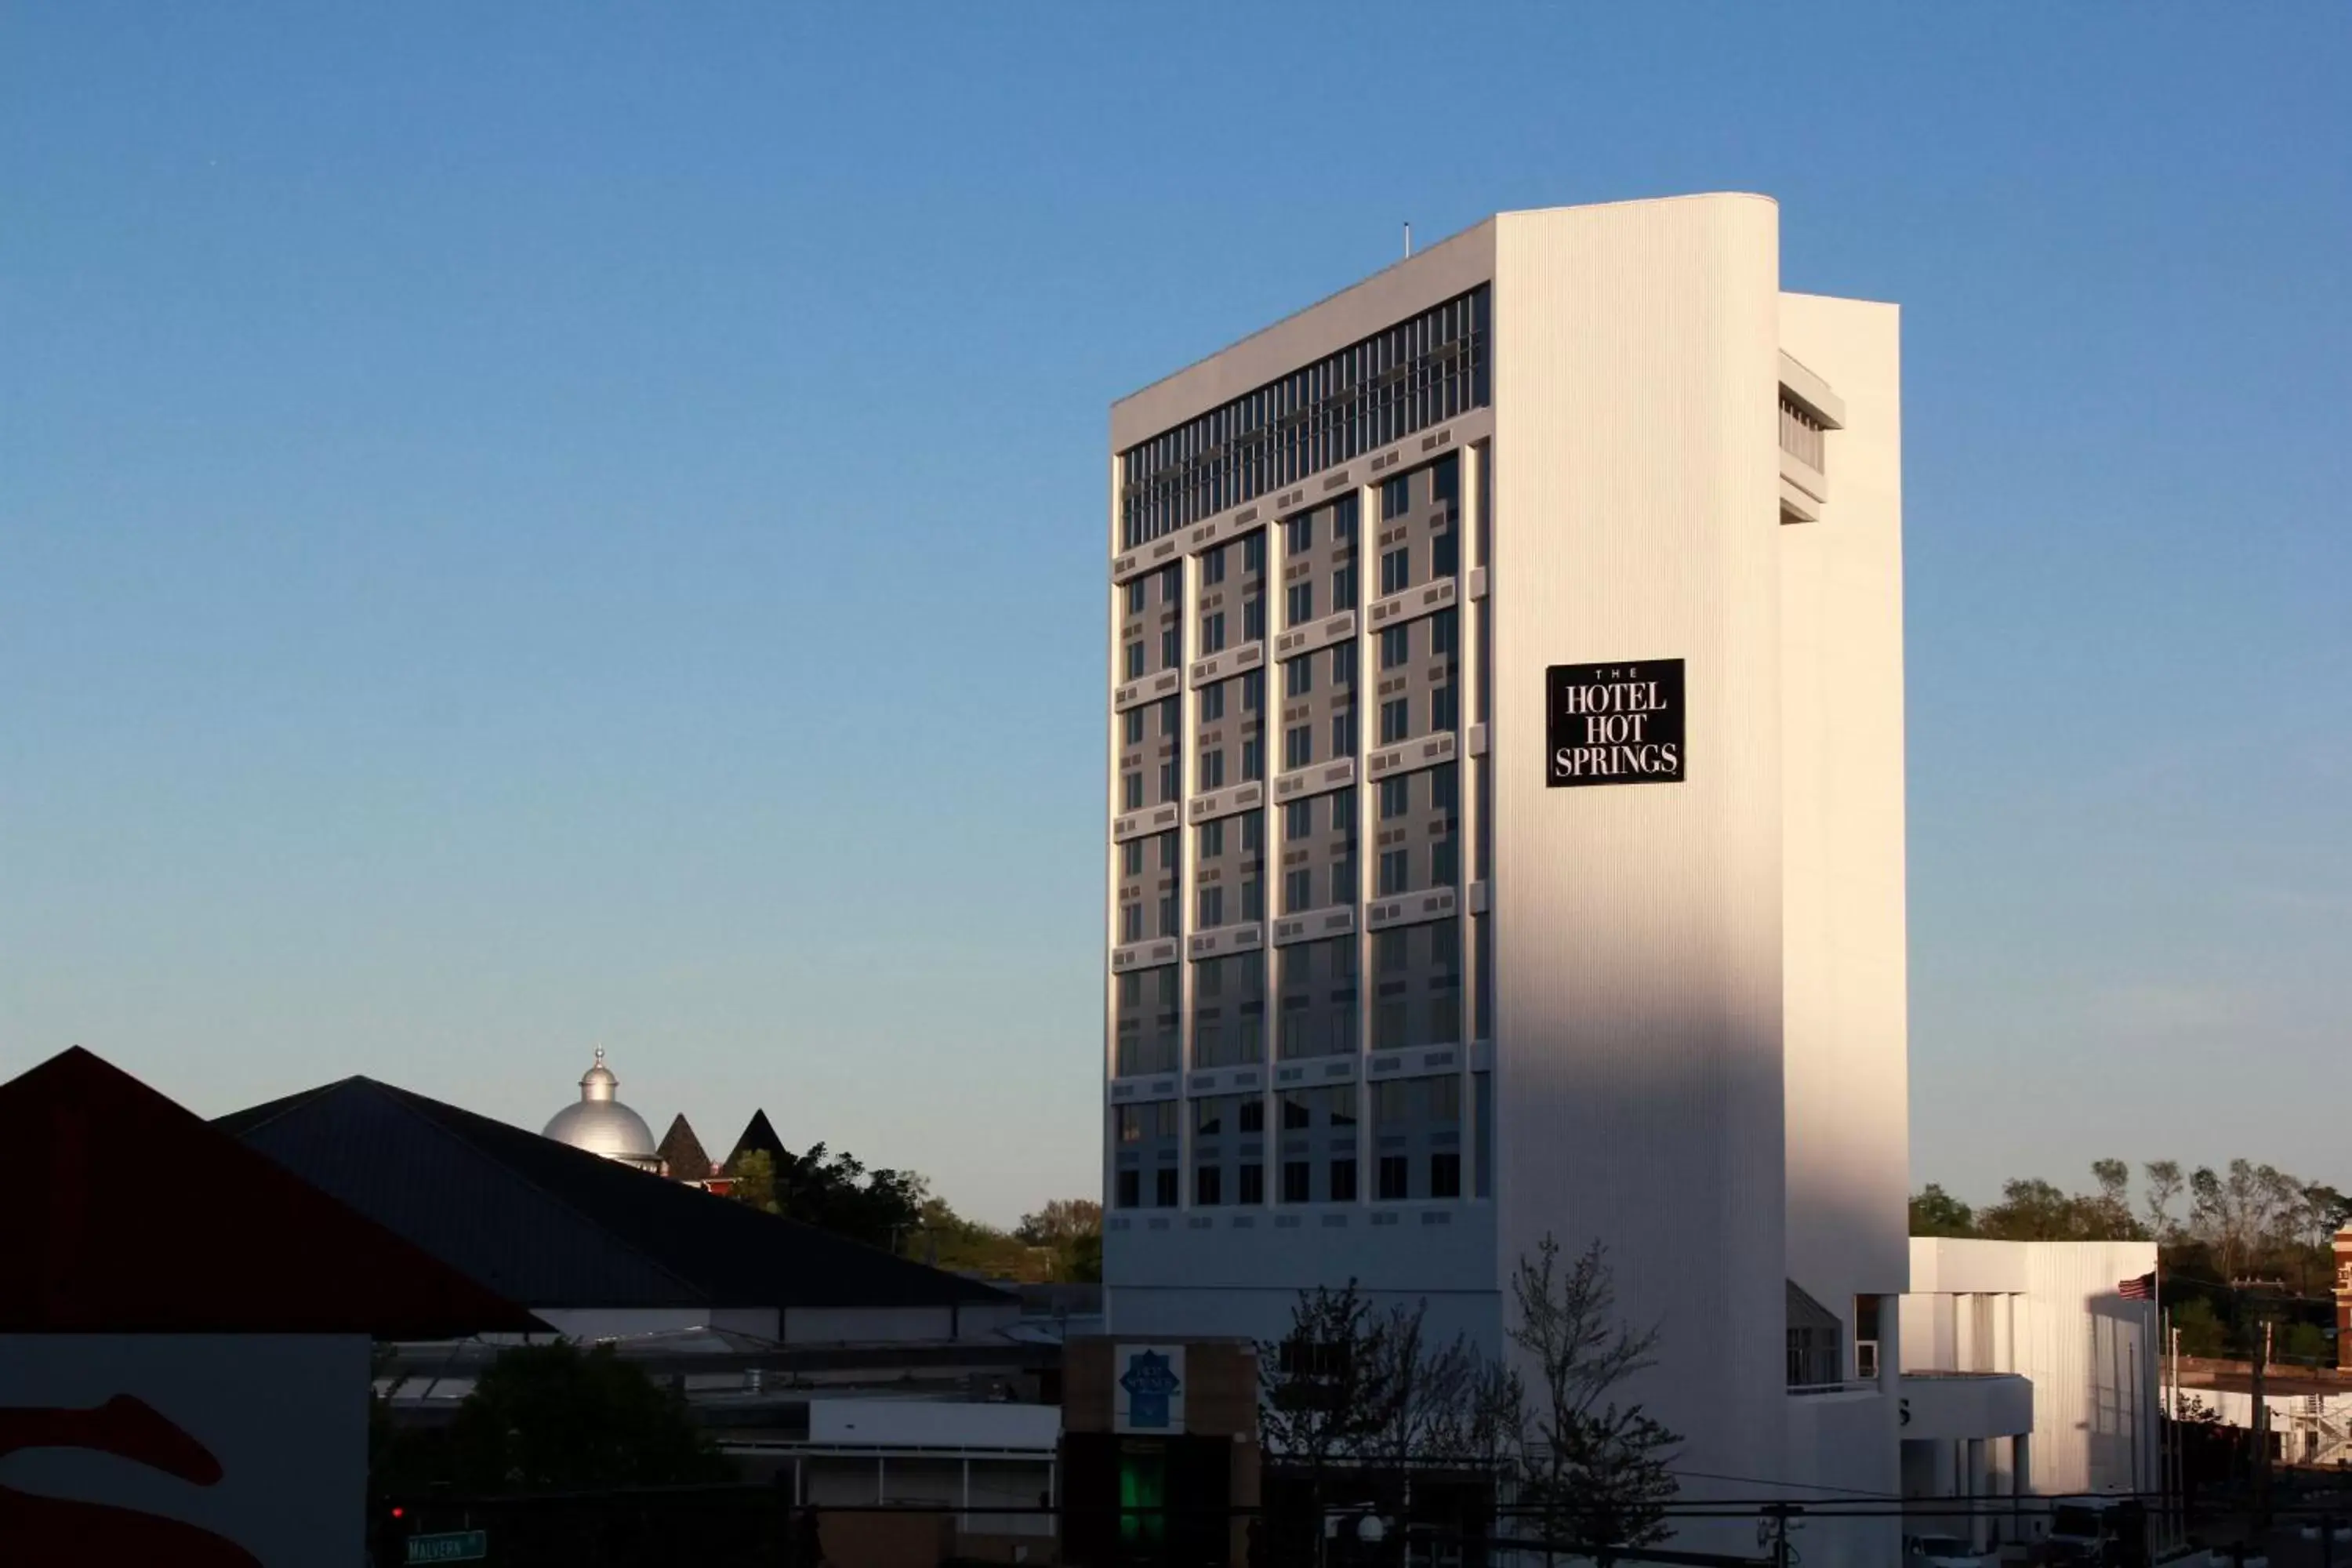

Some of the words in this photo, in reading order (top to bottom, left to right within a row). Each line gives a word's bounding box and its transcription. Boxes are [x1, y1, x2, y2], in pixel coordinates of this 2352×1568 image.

[1595, 667, 1637, 680] THE
[1565, 681, 1668, 714] HOTEL
[1585, 713, 1647, 744] HOT
[1555, 743, 1678, 777] SPRINGS
